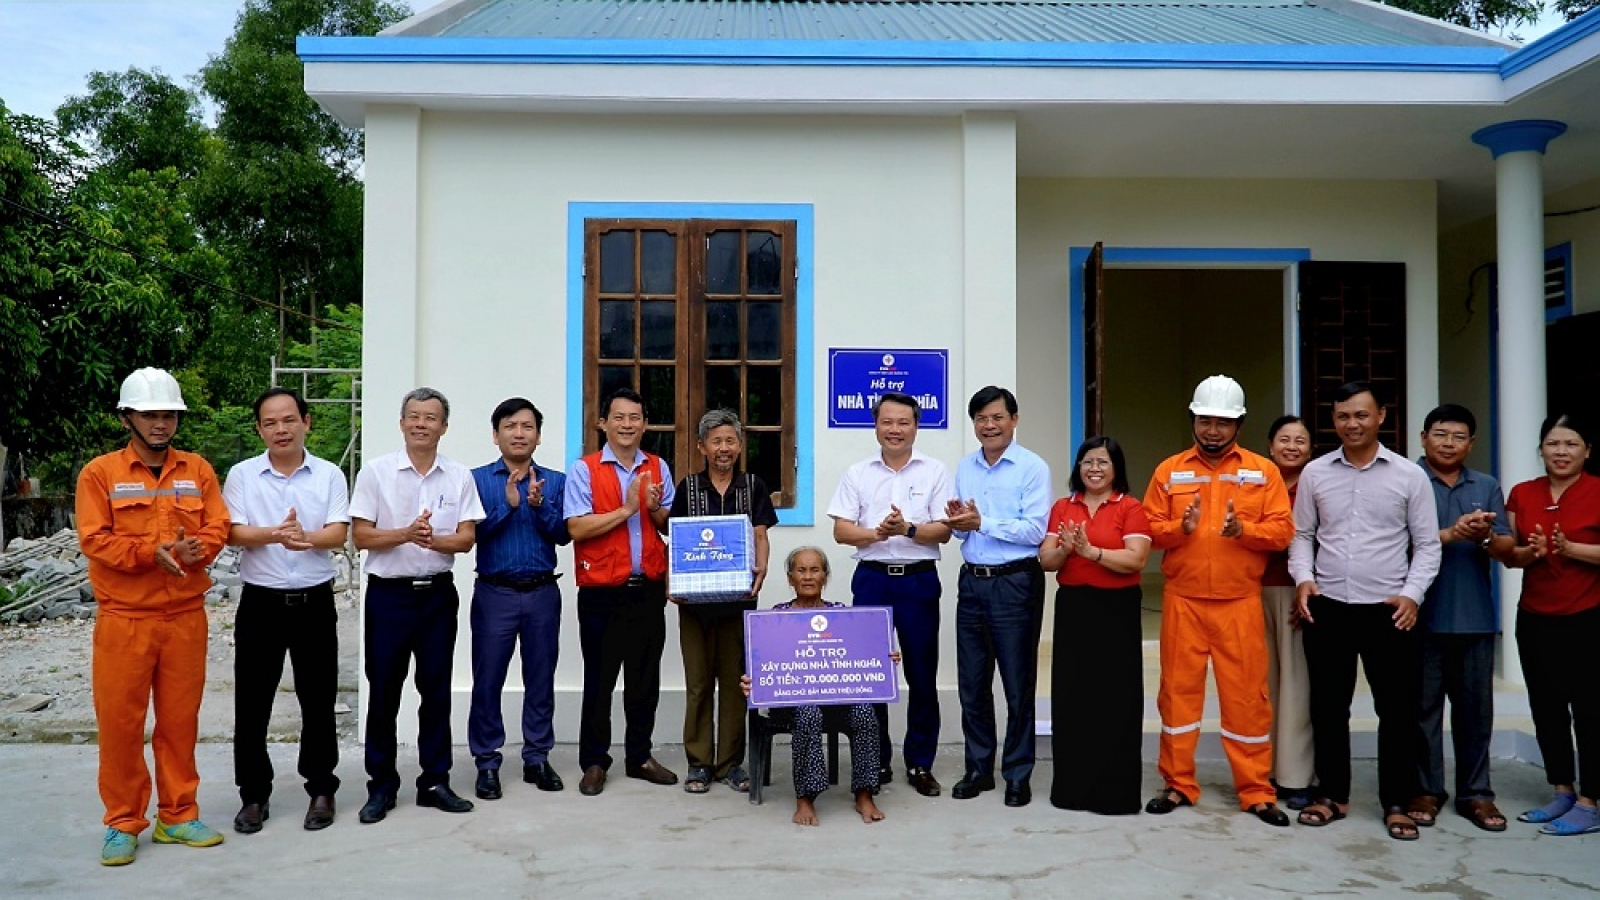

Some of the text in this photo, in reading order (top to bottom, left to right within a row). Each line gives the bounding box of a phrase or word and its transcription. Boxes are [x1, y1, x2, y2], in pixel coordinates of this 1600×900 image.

[870, 377, 905, 391] Hỗ trợ
[838, 392, 864, 409] NHÀ
[795, 645, 847, 658] HỖ TRỢ
[761, 657, 882, 673] XÂY DỰNG NHÀ TÌNH NGHĨA
[759, 673, 774, 686] SỐ
[776, 673, 801, 685] TIỀN:
[803, 674, 862, 684] 70.000.000
